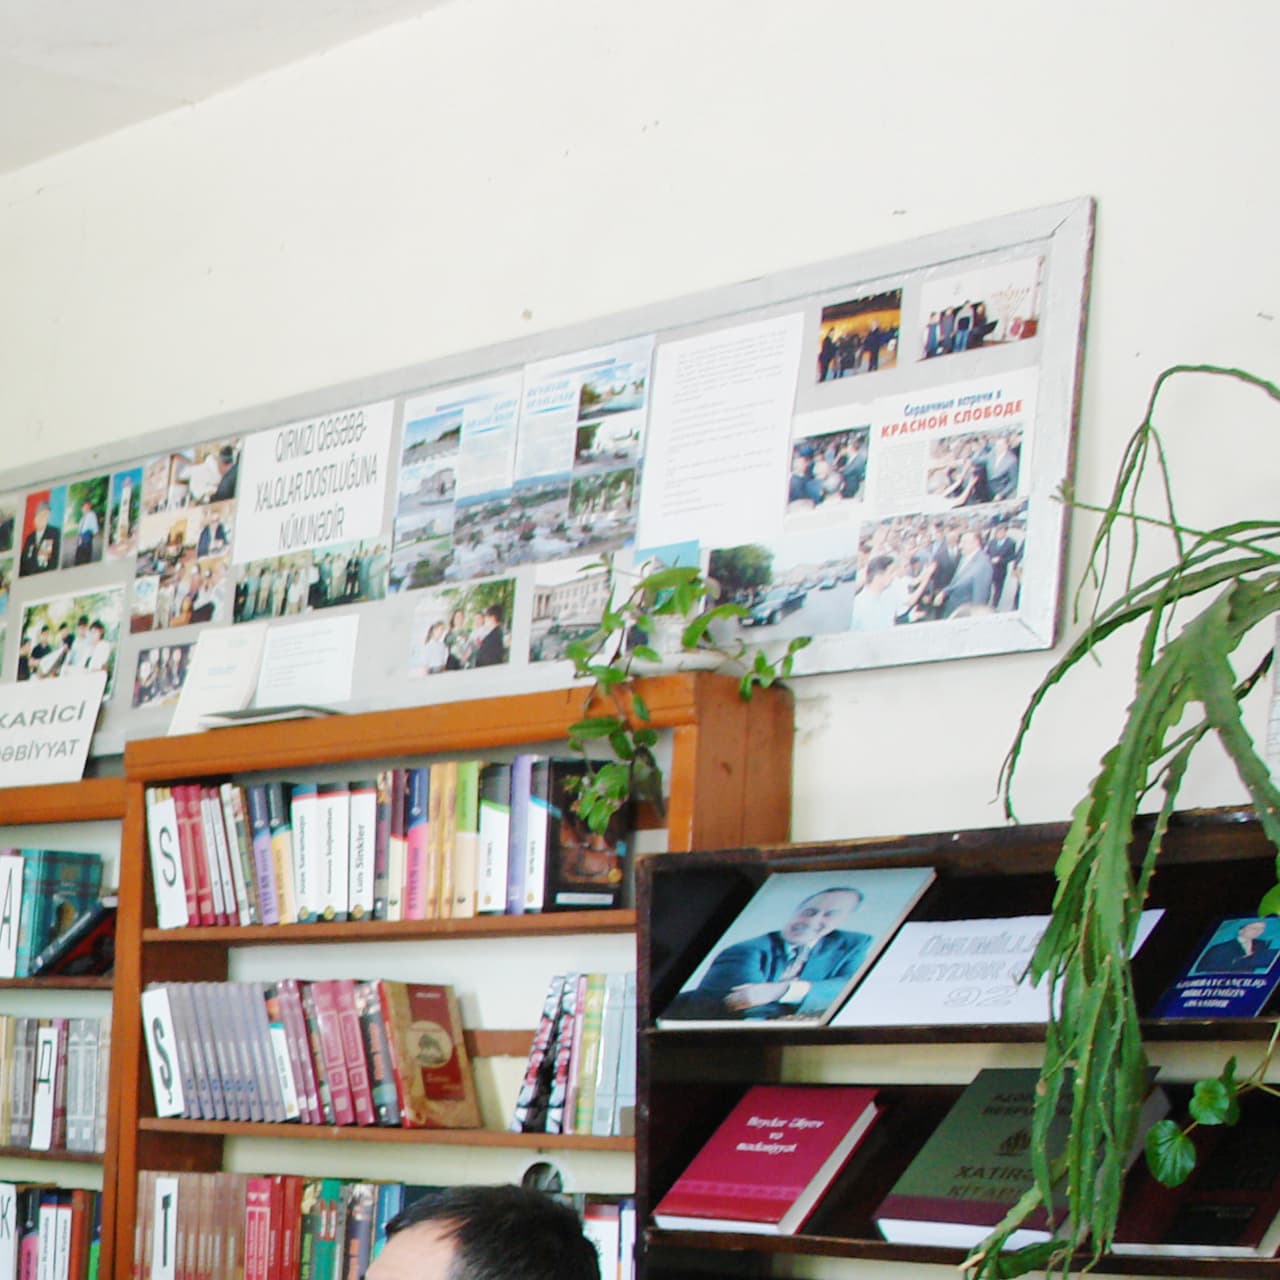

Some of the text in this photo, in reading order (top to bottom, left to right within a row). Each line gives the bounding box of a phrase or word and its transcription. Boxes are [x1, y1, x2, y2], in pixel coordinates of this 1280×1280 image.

[881, 399, 1023, 438] КРАСНОЙ СЛОБОДЕ
[1, 1195, 11, 1239] K
